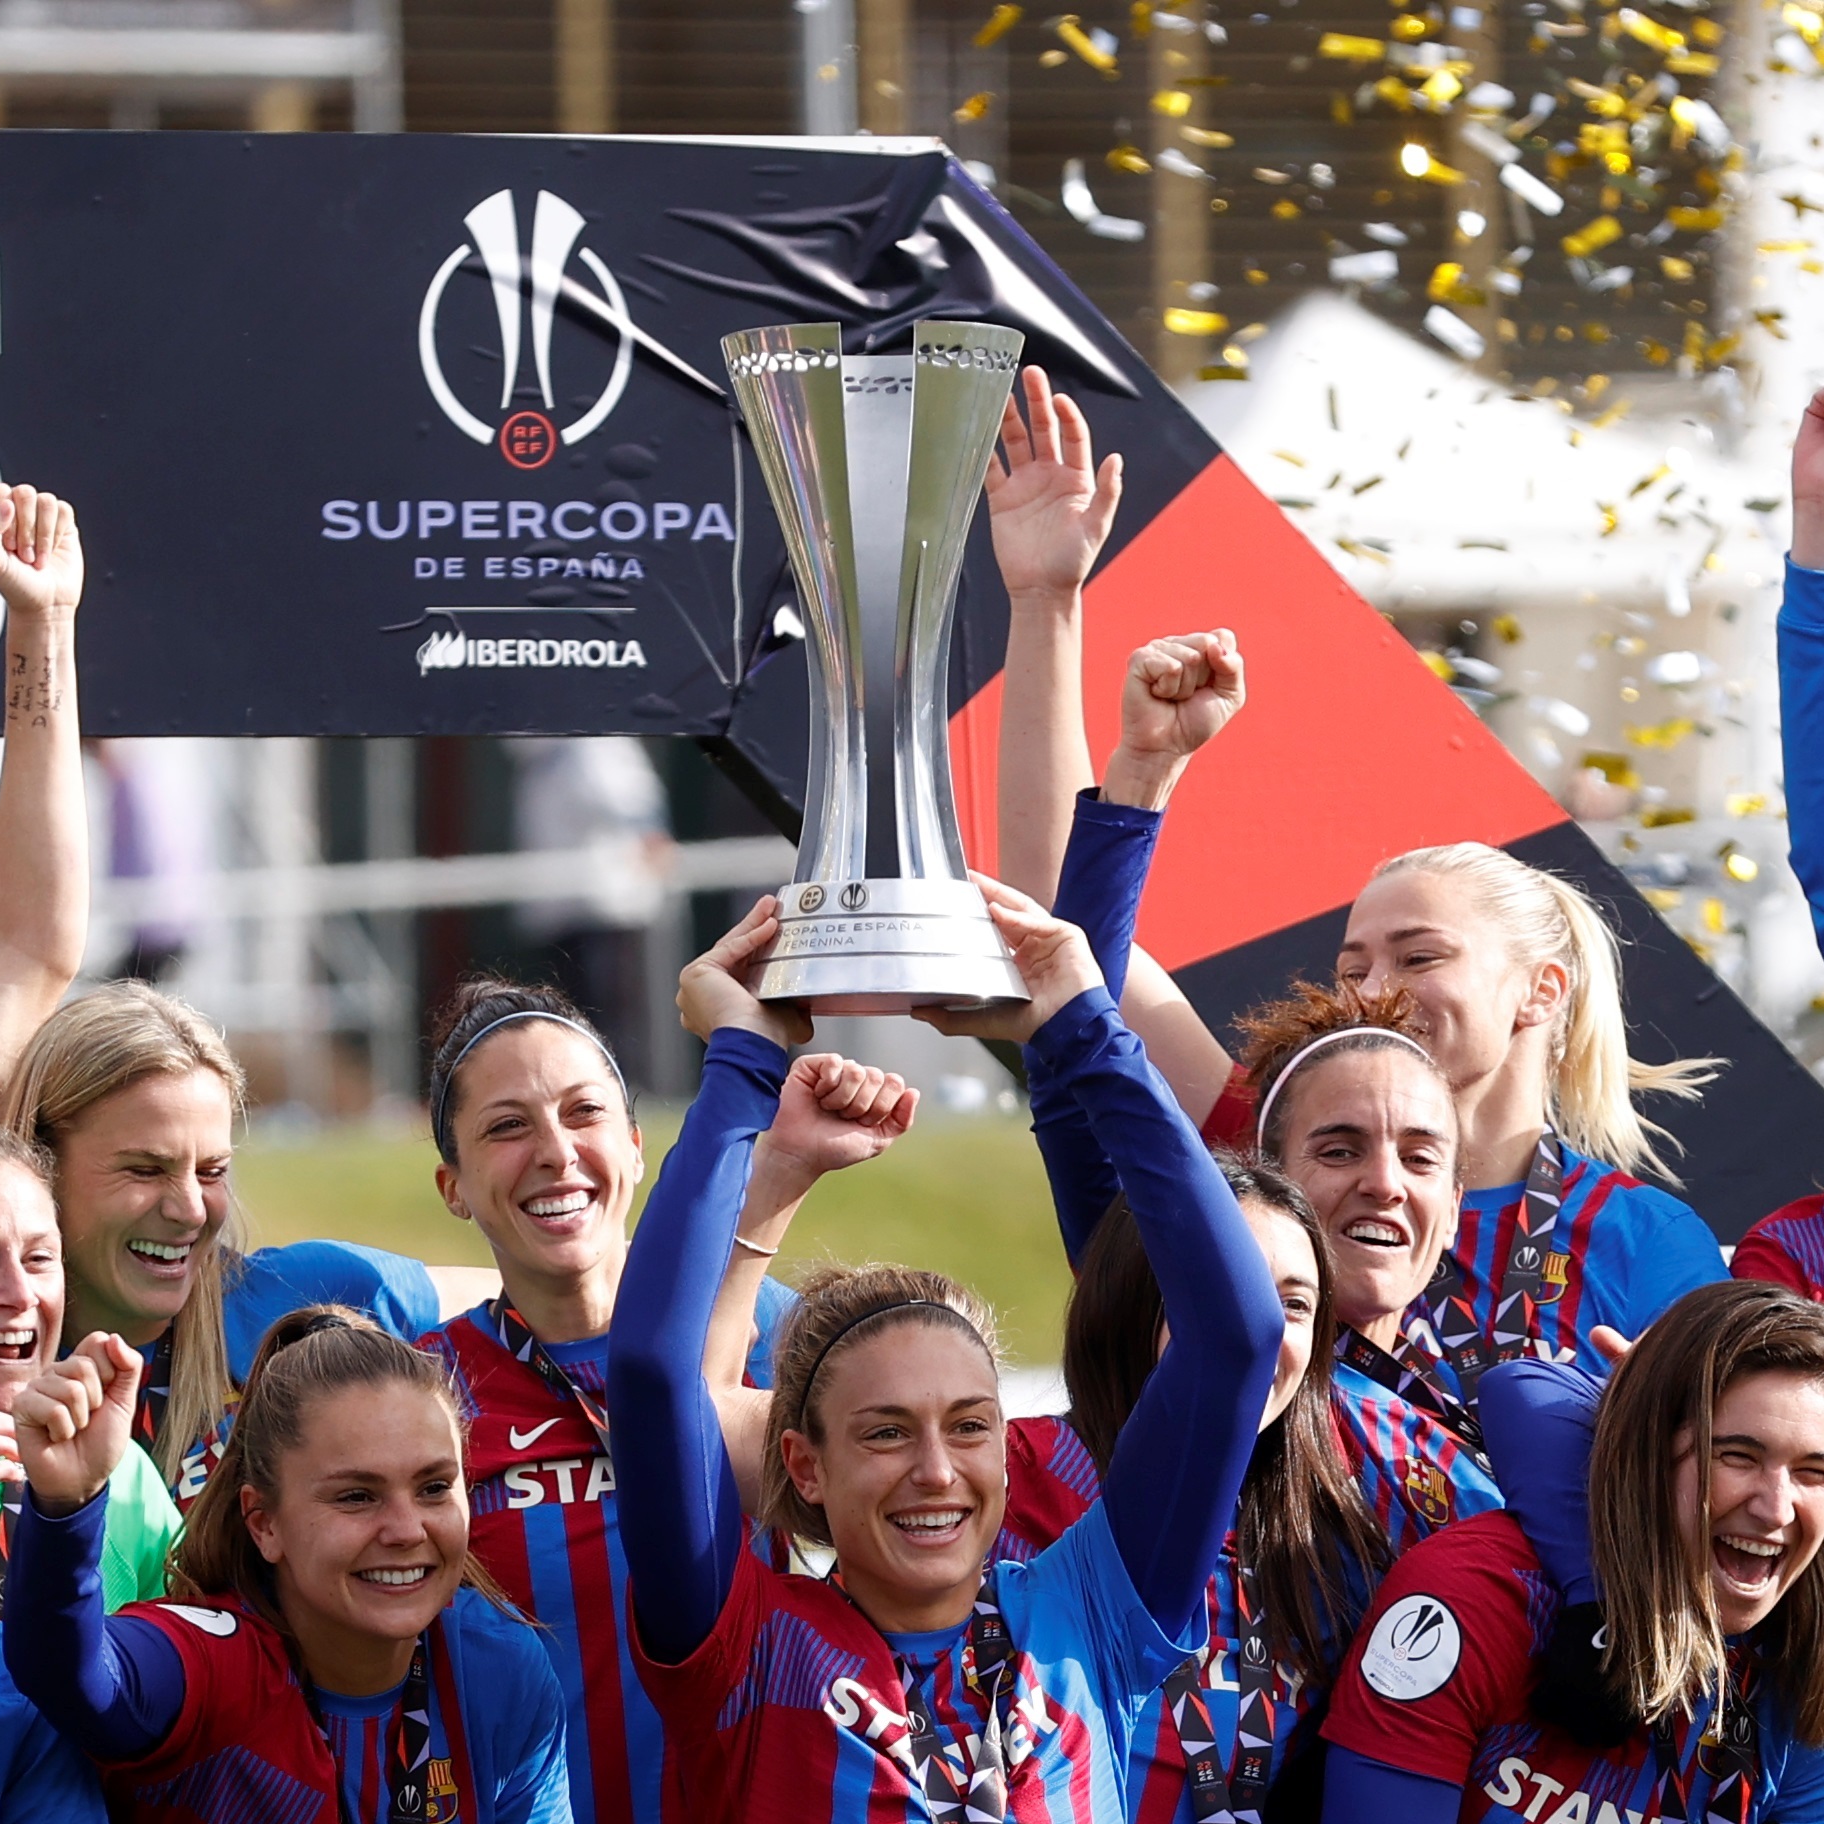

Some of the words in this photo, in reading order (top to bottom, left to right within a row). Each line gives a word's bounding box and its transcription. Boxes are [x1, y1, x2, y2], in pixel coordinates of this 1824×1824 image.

[321, 500, 735, 541] SUPERCOPA
[414, 557, 466, 579] DE
[484, 553, 645, 579] ESPAÑA
[467, 639, 646, 667] IBERDROLA
[826, 923, 847, 932] DE
[853, 920, 925, 932] ESPAÑA
[783, 936, 854, 949] FEMENINA
[507, 1459, 616, 1509] STA
